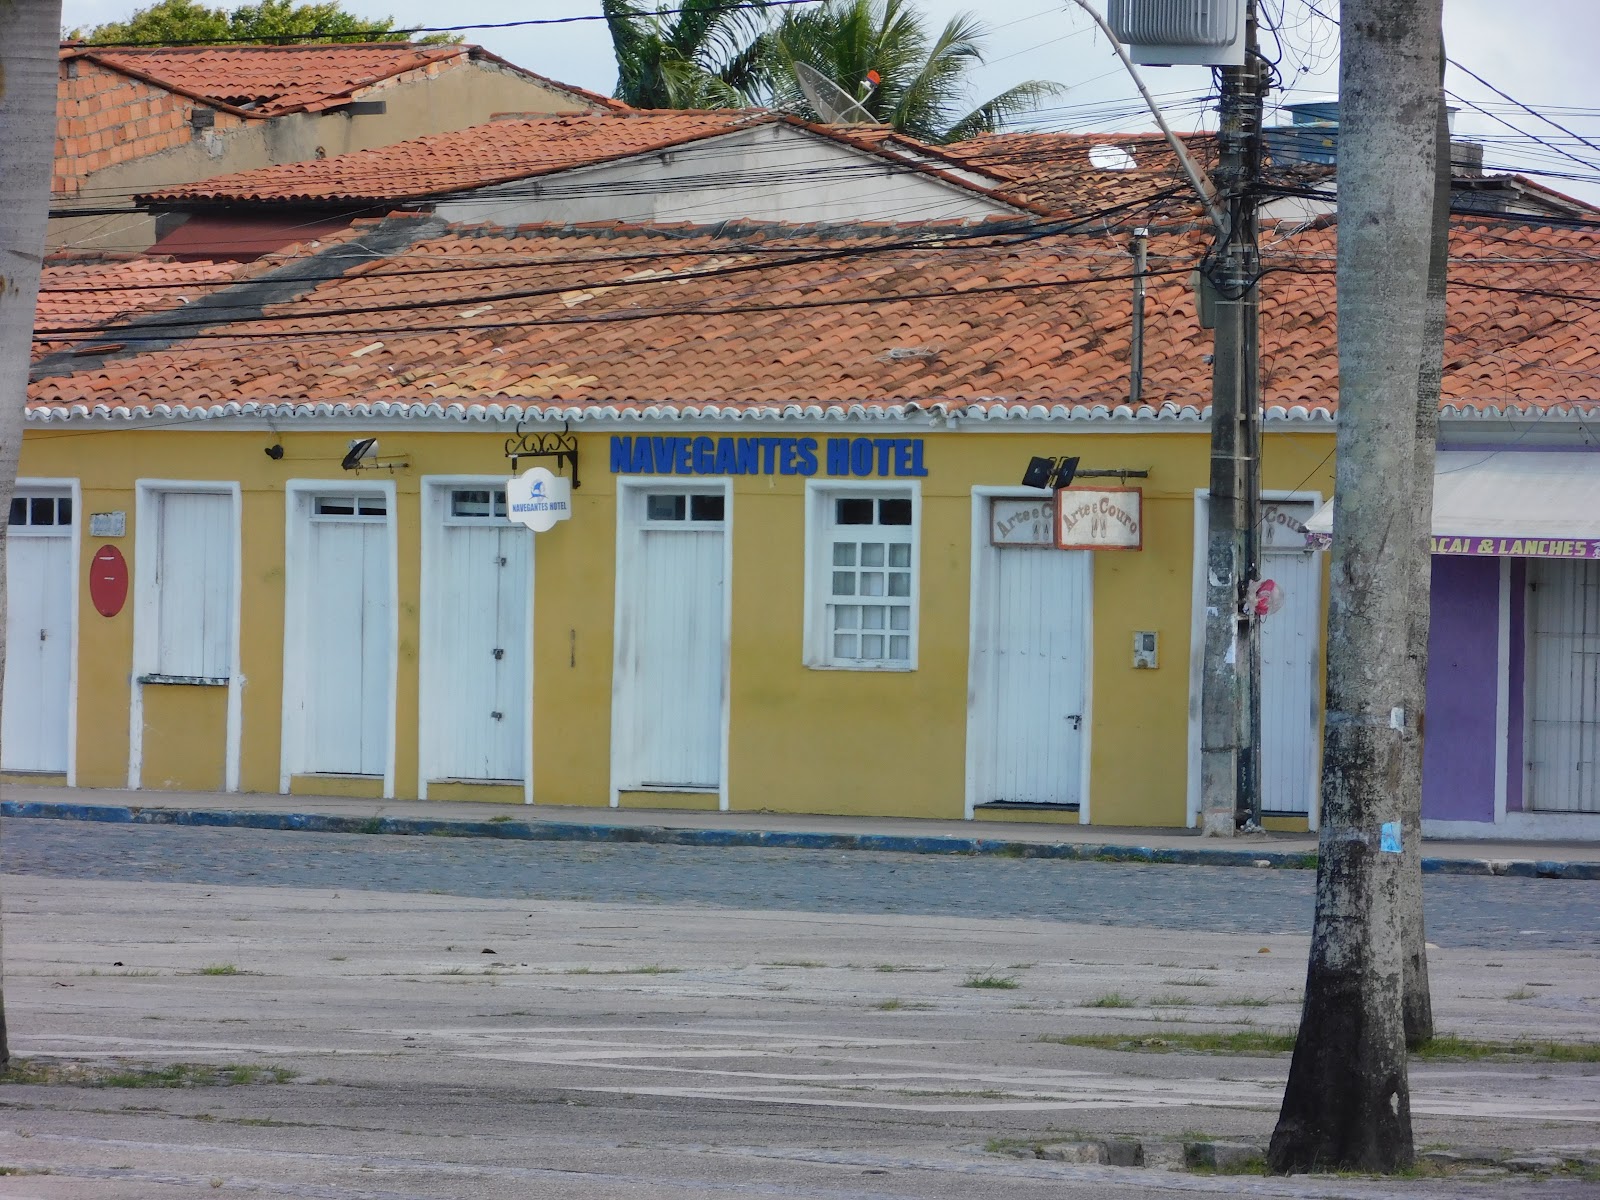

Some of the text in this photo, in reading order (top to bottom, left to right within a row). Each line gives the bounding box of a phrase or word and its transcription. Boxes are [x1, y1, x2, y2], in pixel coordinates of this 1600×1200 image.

[610, 435, 928, 477] NAVEGANTES HOTEL
[512, 501, 567, 512] NAVEGANTES HOTEL
[1063, 504, 1090, 532] Arte
[1092, 502, 1098, 513] e
[1099, 497, 1138, 534] Couro
[996, 510, 1030, 538] Arte
[1032, 508, 1040, 519] e
[1477, 539, 1495, 554] &
[1498, 539, 1587, 556] LANCHES
